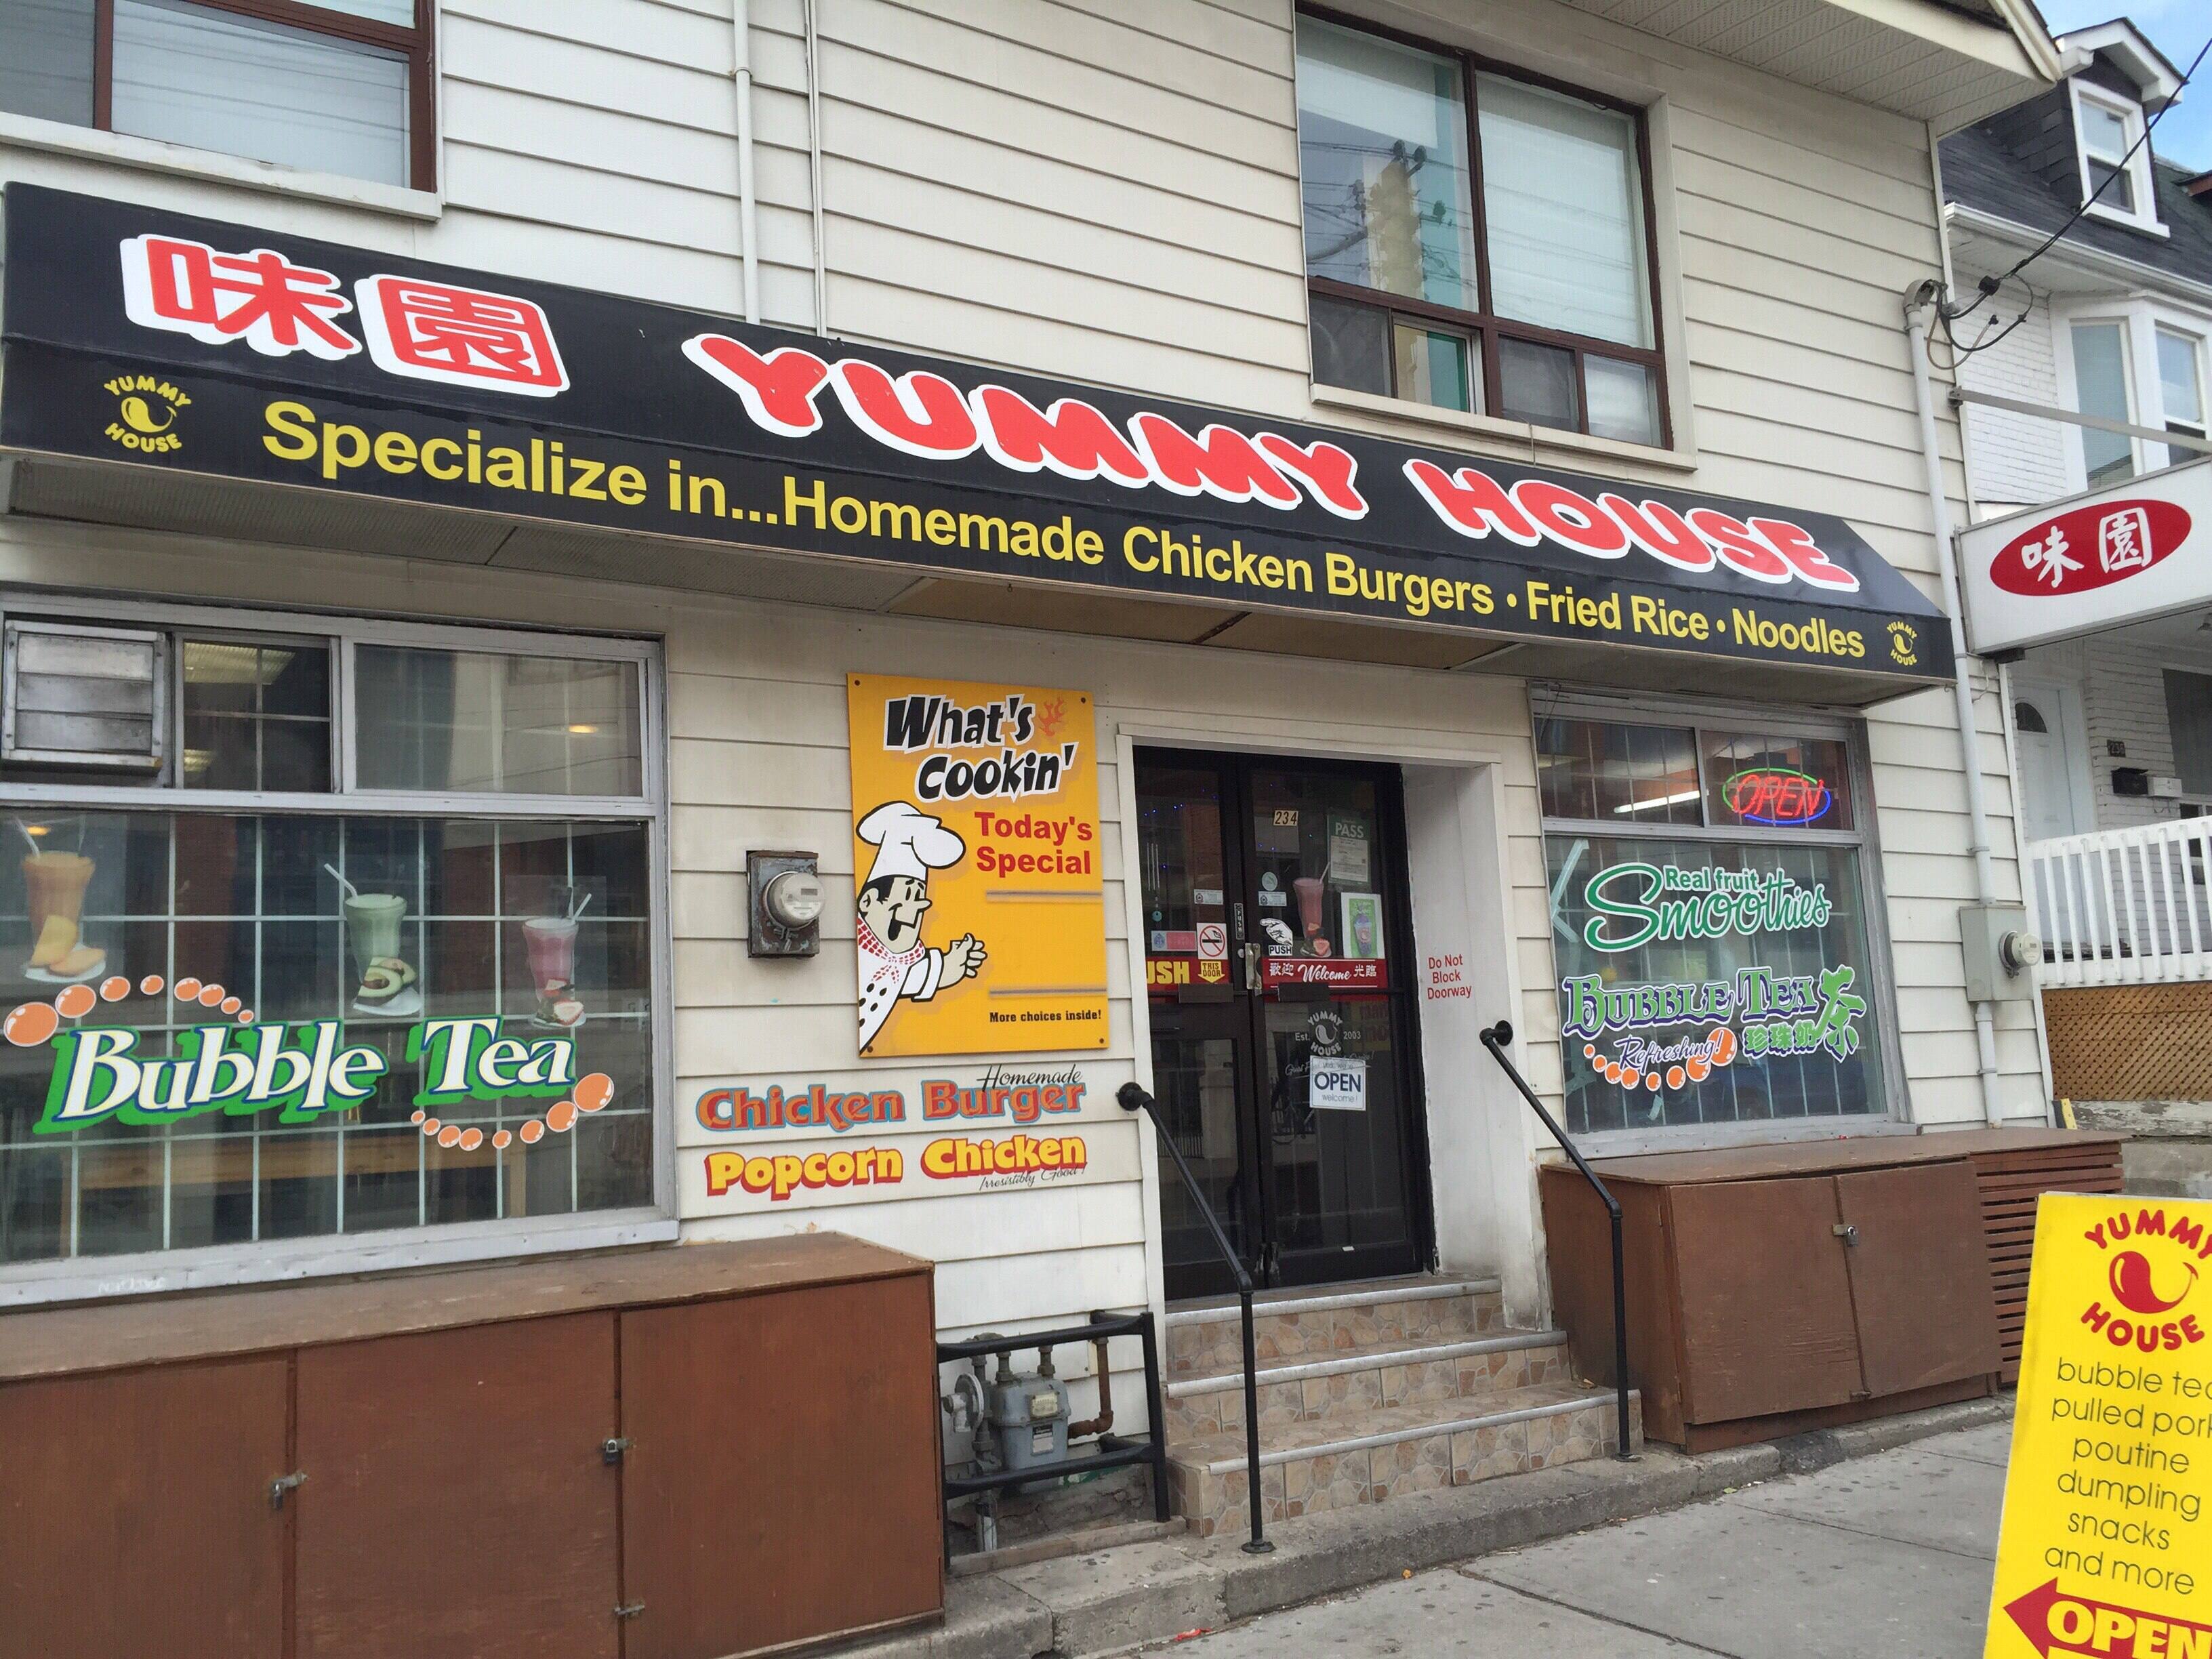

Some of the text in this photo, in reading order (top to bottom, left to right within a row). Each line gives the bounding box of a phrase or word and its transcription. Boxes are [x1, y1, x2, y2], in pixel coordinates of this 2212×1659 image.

[121, 234, 570, 397] 味園
[104, 375, 192, 407] YUMMY
[105, 423, 182, 452] HOUSE
[682, 333, 1860, 592] YUMMY HOUSE
[262, 401, 647, 506] Specialize
[1123, 526, 1313, 592] Chicken
[1326, 552, 1494, 617] Burgers
[1526, 579, 1622, 630] Fried
[1631, 594, 1709, 640] Rice
[1732, 608, 1866, 658] Noodles
[2021, 507, 2153, 588] 味園
[1886, 621, 1917, 639] YUMMY
[1890, 649, 1917, 665] HOUSE
[884, 696, 1034, 750] What's
[917, 744, 1076, 801] Cookin'
[1731, 774, 1825, 817] OPEN
[975, 811, 1093, 846] Today's
[1275, 812, 1297, 825] 234
[1335, 822, 1364, 839] PASS
[976, 846, 1091, 878] Special
[1665, 866, 1758, 891] Real fruit
[1584, 863, 1831, 951] Smoothies
[1269, 945, 1292, 955] PUSH
[1429, 954, 1463, 969] Do Not
[1269, 962, 1294, 977] 歡迎
[1297, 964, 1352, 983] Welcome
[1353, 964, 1377, 977] 光臨
[1433, 969, 1461, 984] Block
[1427, 985, 1472, 1000] Doorway
[989, 1009, 1101, 1023] More choices inside!
[1307, 1010, 1343, 1025] YUMMY
[1743, 965, 1866, 1062] 珍珠奶茶
[1295, 1032, 1310, 1041] Est.
[1310, 1042, 1342, 1056] HOUSE
[1343, 1031, 1361, 1040] 2003
[1614, 1029, 1722, 1075] Refreshing!
[37, 1017, 577, 1133] Bubble Tea
[976, 1064, 1082, 1092] Homemade
[1314, 1071, 1361, 1092] OPEN
[696, 1080, 1086, 1132] Chicken Burger
[1322, 1093, 1358, 1103] welcome!
[705, 1134, 1087, 1201] Popcorn Chicken
[979, 1170, 1036, 1191] Irresistibly
[2084, 1209, 2212, 1260] YUMMY
[2081, 1302, 2205, 1353] HOUSE
[2057, 1357, 2163, 1393] bubble
[2051, 1397, 2145, 1425] pulled
[2072, 1437, 2190, 1474] poutine
[2057, 1469, 2201, 1522] dumpling
[2068, 1512, 2170, 1551] snacks
[2045, 1547, 2194, 1595] and more
[2046, 1600, 2212, 1659] OPEN
